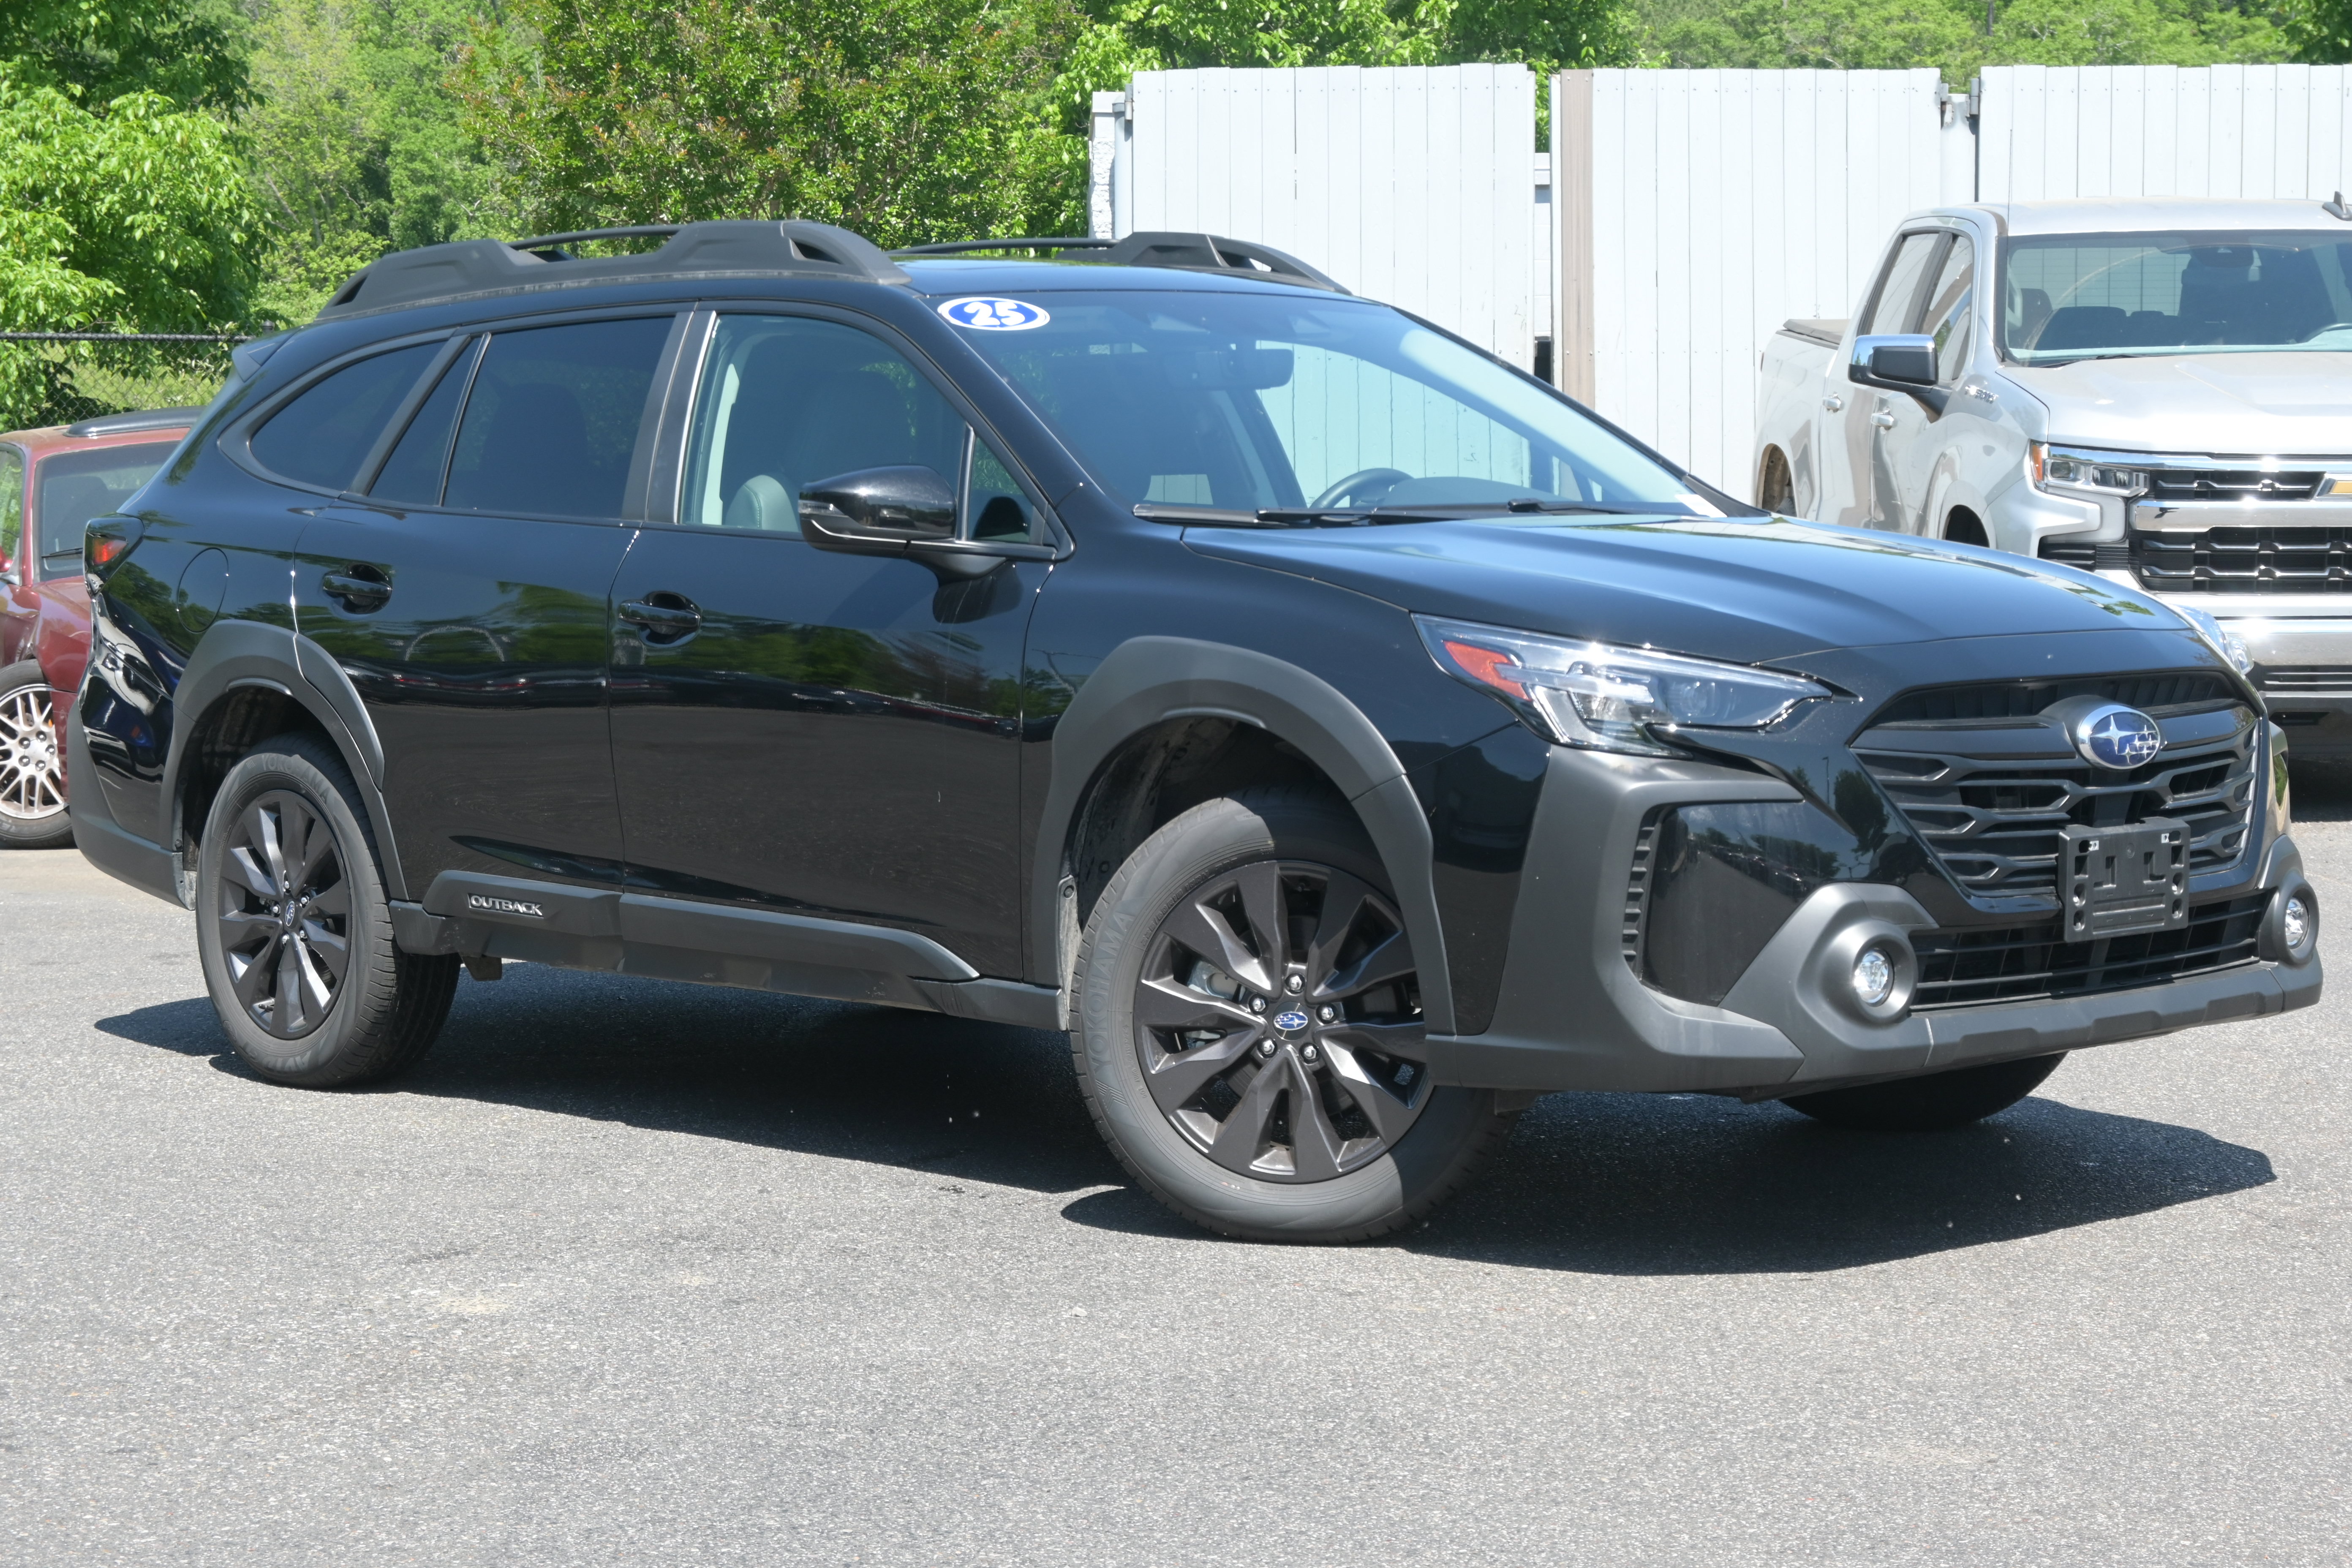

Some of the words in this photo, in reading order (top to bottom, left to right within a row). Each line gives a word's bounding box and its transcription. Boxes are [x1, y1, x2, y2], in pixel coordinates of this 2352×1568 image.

[964, 301, 1025, 326] 25
[261, 754, 331, 804] YOKOAMA
[470, 895, 543, 916] OUTBACK
[1087, 911, 1135, 1074] YOKOHAMA
